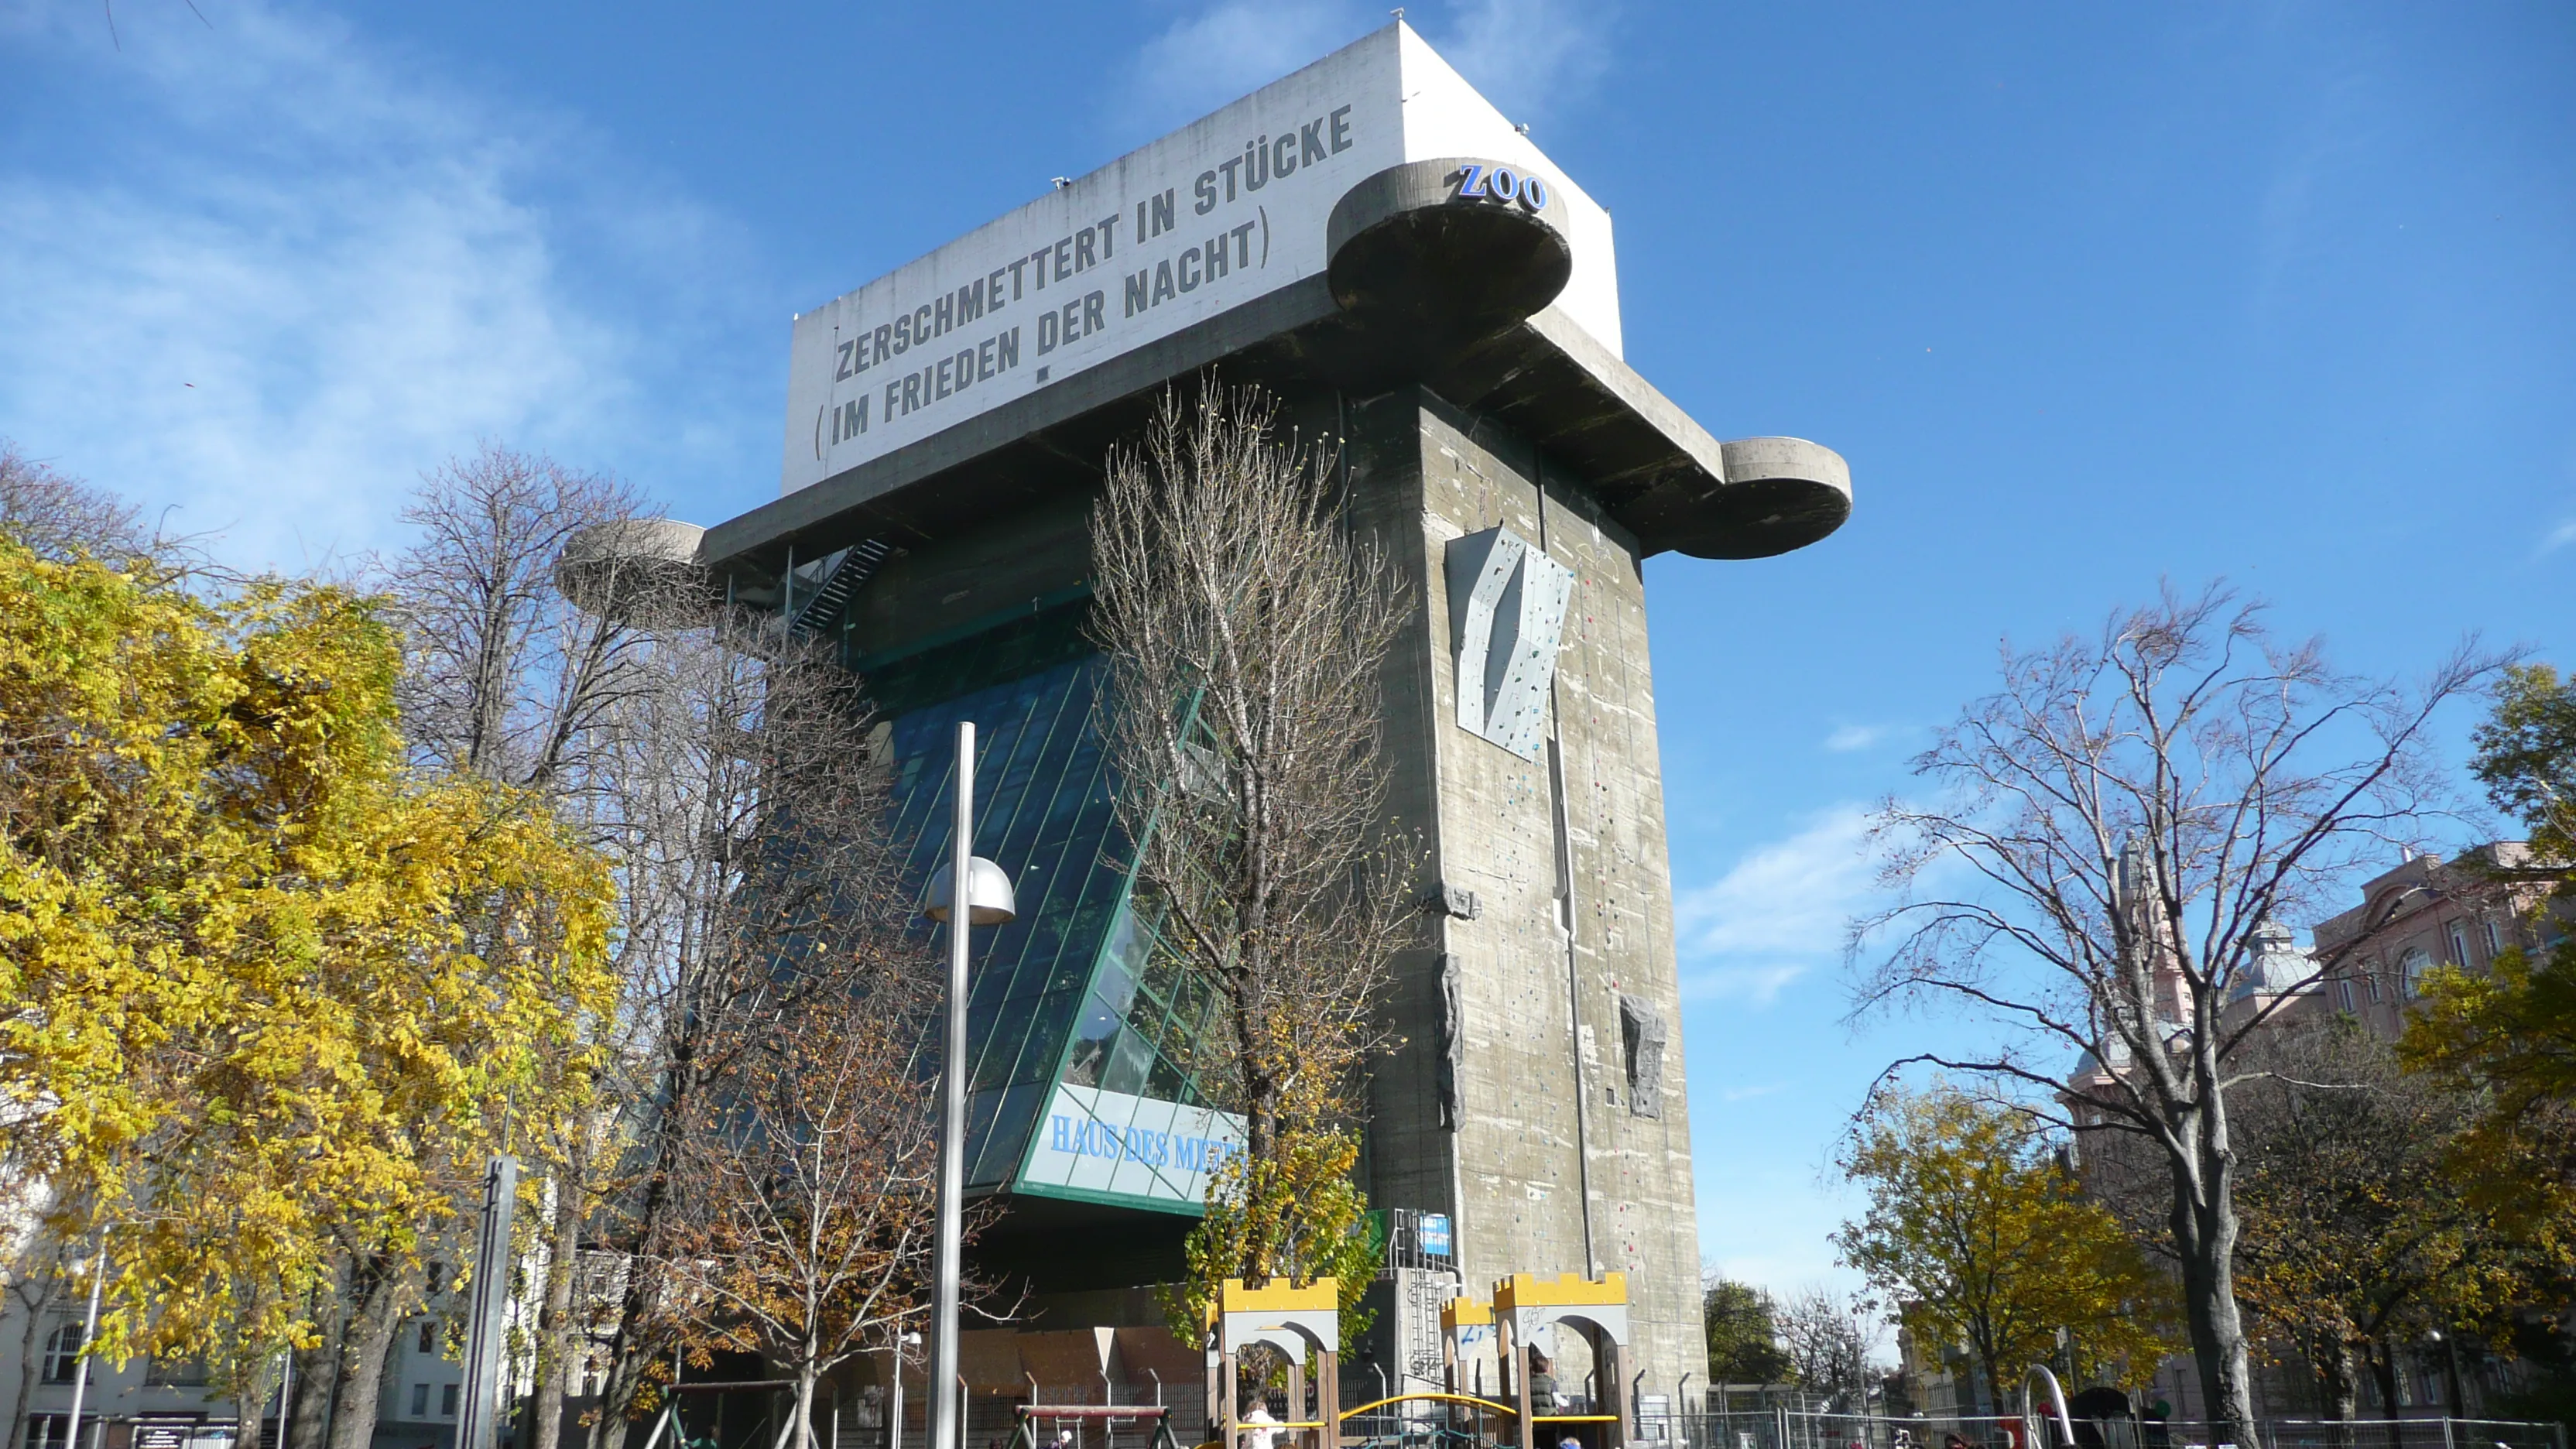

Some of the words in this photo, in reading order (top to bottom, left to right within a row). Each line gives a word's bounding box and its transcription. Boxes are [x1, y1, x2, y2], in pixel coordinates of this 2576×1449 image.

[835, 214, 1119, 383] ZERSCHMETTERT
[1136, 187, 1175, 245] IN
[1194, 103, 1353, 216] STÜCKE
[1458, 163, 1548, 211] ZOO
[814, 393, 870, 461] (IM
[884, 325, 1020, 424] FRIEDEN
[1036, 289, 1105, 357] DER
[1124, 204, 1269, 319] NACHT)
[1050, 1114, 1118, 1160] HAUS
[1123, 1126, 1170, 1167] DES
